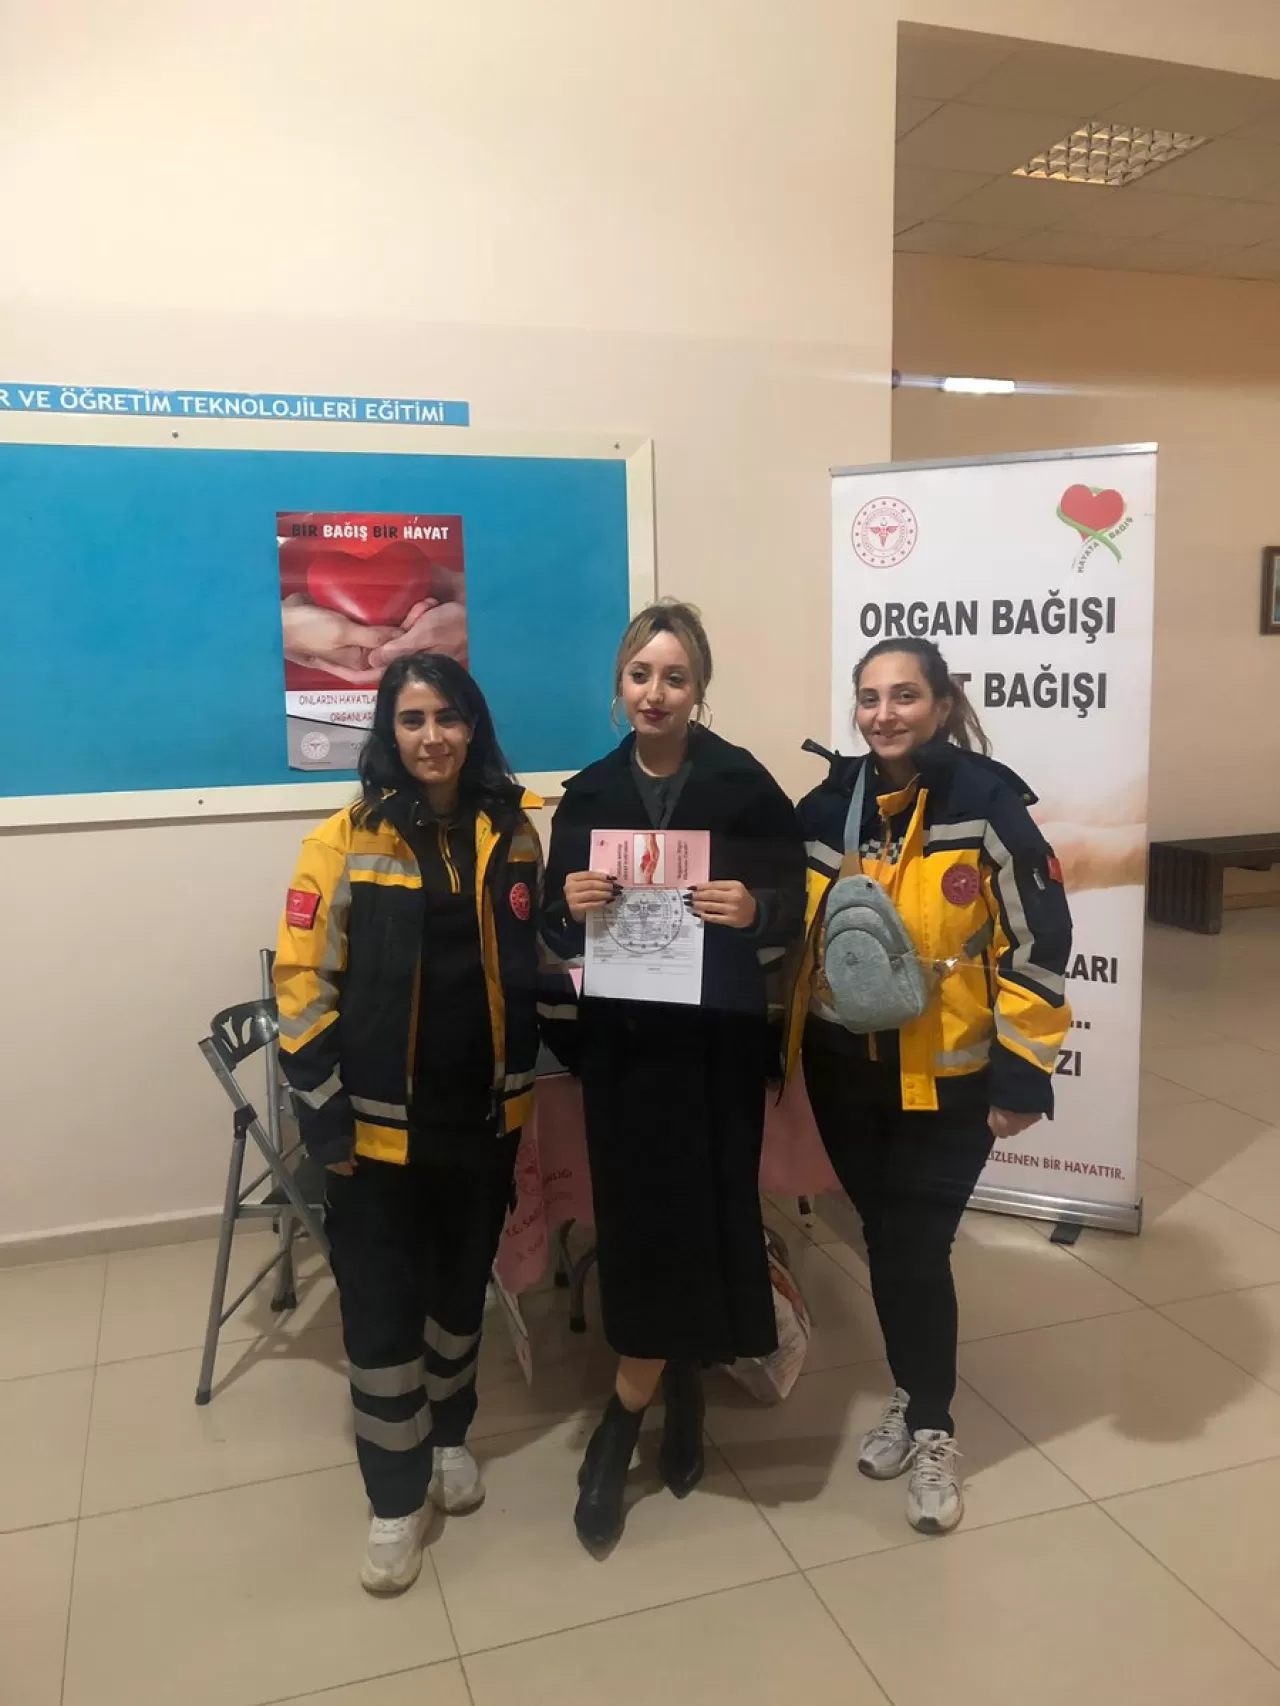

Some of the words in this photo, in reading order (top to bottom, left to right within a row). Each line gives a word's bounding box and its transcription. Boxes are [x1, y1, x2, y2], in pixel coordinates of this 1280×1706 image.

[18, 390, 51, 409] VE
[60, 387, 173, 413] ÖĞRETİM
[178, 396, 357, 420] TEKNOLOJİLERİ
[365, 400, 445, 422] EĞİTİMİ
[323, 521, 368, 542] BAĞIŞ
[373, 524, 399, 538] BİR
[403, 525, 449, 540] HAYAT
[860, 600, 978, 638] ORGAN
[992, 589, 1116, 643] BAĞIŞI
[984, 664, 1107, 718] BAĞIŞI
[1065, 953, 1118, 984] ARI
[1043, 1155, 1061, 1171] BİR
[1064, 1160, 1126, 1181] HAYATTIR.
